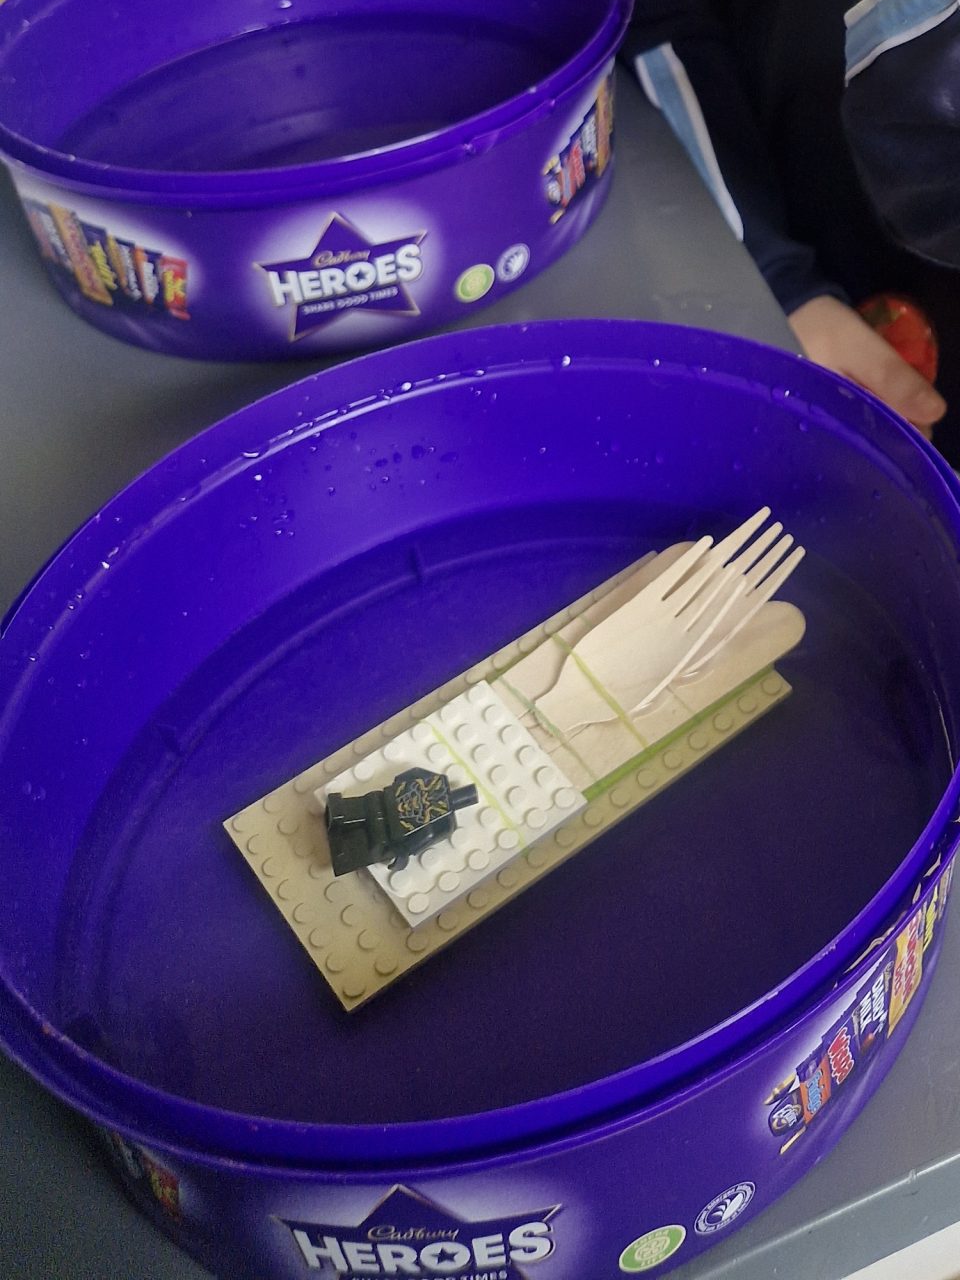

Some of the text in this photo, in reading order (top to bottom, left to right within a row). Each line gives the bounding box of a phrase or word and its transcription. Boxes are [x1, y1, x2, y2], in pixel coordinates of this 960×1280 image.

[269, 244, 423, 307] HEROES
[314, 250, 370, 268] Cadbury
[293, 1221, 556, 1273] HEROES
[368, 1224, 459, 1242] Cadbury
